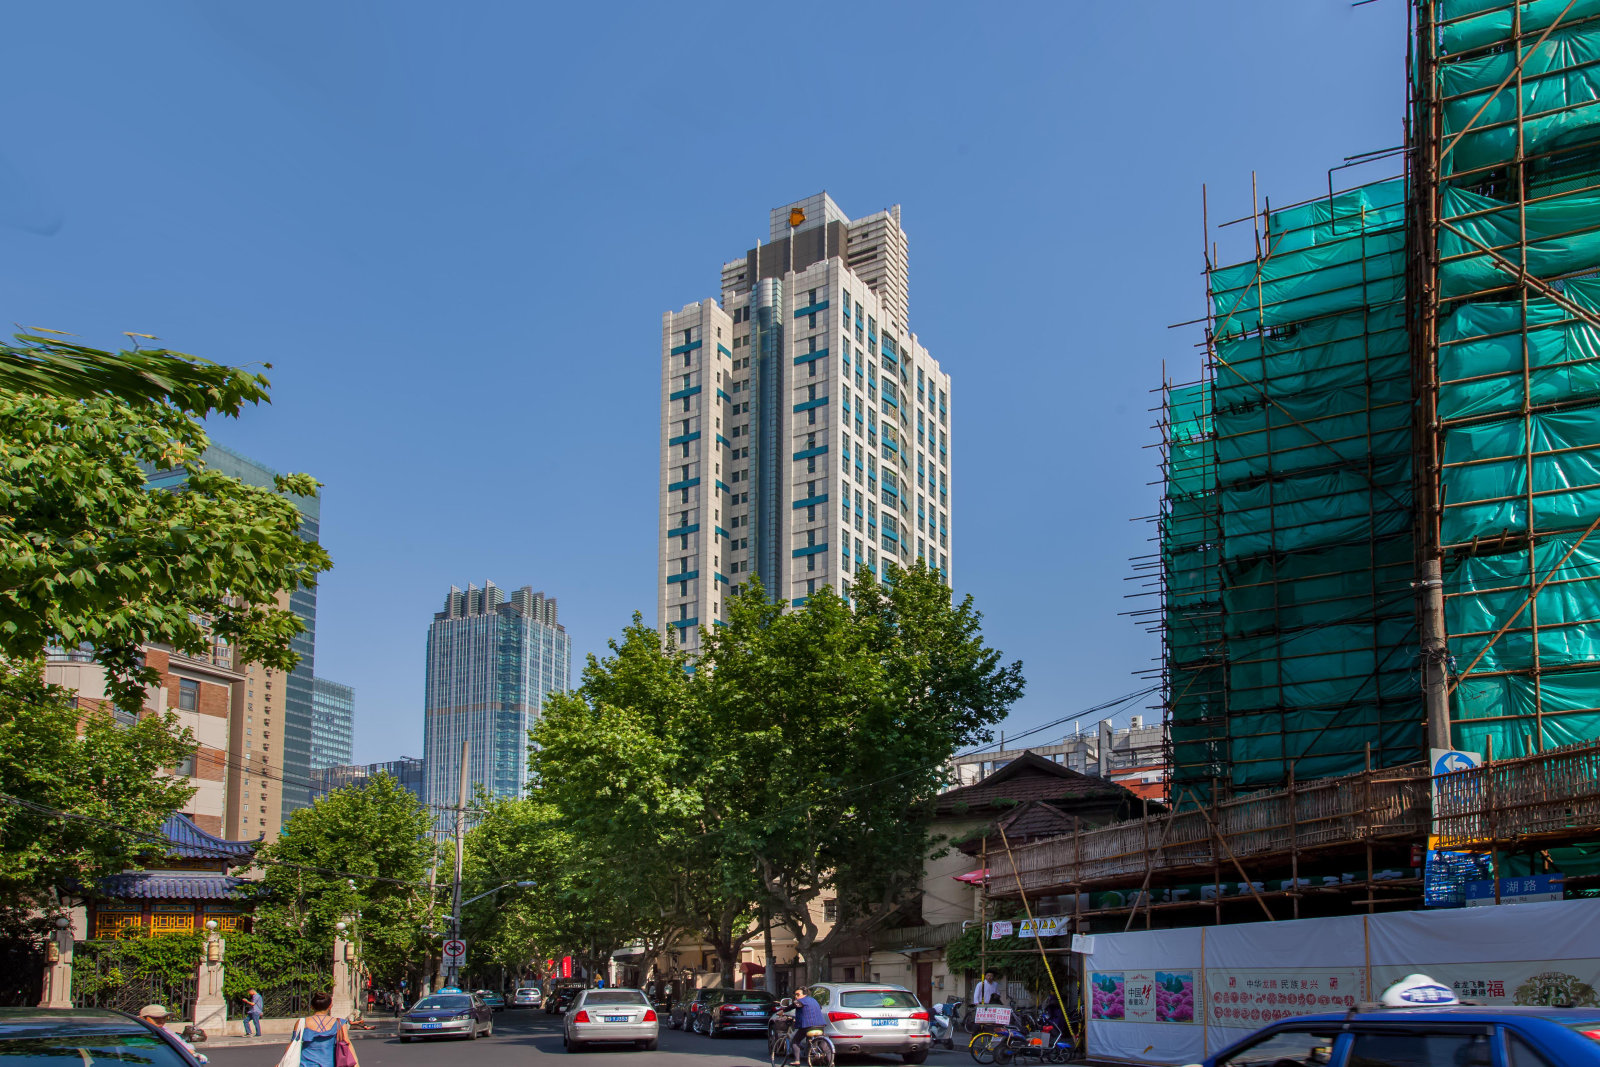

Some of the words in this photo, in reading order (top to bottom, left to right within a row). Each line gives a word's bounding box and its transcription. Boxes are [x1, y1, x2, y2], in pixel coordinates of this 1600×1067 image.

[1500, 896, 1517, 904] onghu
[1280, 979, 1319, 990] 民族复兴
[1486, 980, 1505, 997] 福
